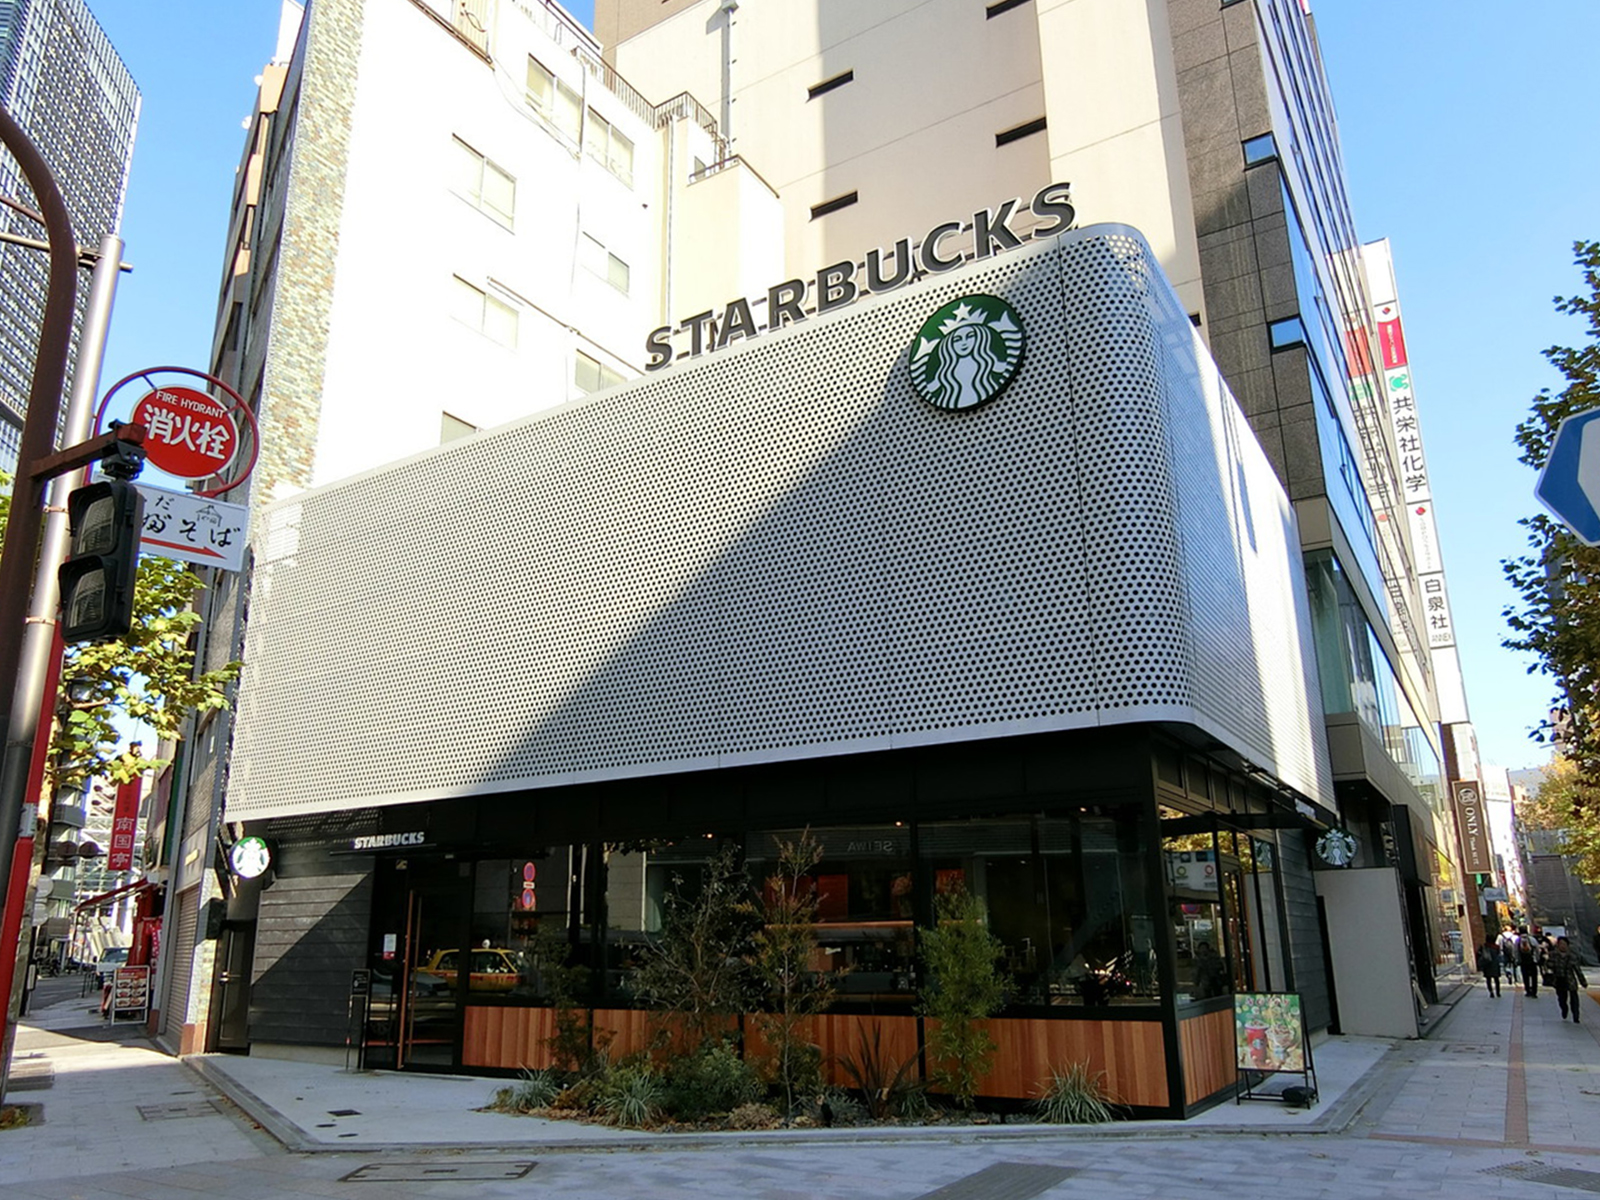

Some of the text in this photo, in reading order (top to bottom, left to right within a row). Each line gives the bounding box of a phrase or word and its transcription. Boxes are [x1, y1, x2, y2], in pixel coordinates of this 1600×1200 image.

[645, 181, 1077, 372] STARBUCKS
[155, 390, 226, 419] FIRE HYDRANT
[143, 404, 231, 460] 消火栓
[1392, 396, 1426, 493] 共栄社化学
[1424, 577, 1449, 630] 白泉社
[111, 817, 134, 867] 南国亭
[354, 831, 425, 849] STARBUCKS
[1464, 807, 1479, 836] ONLY
